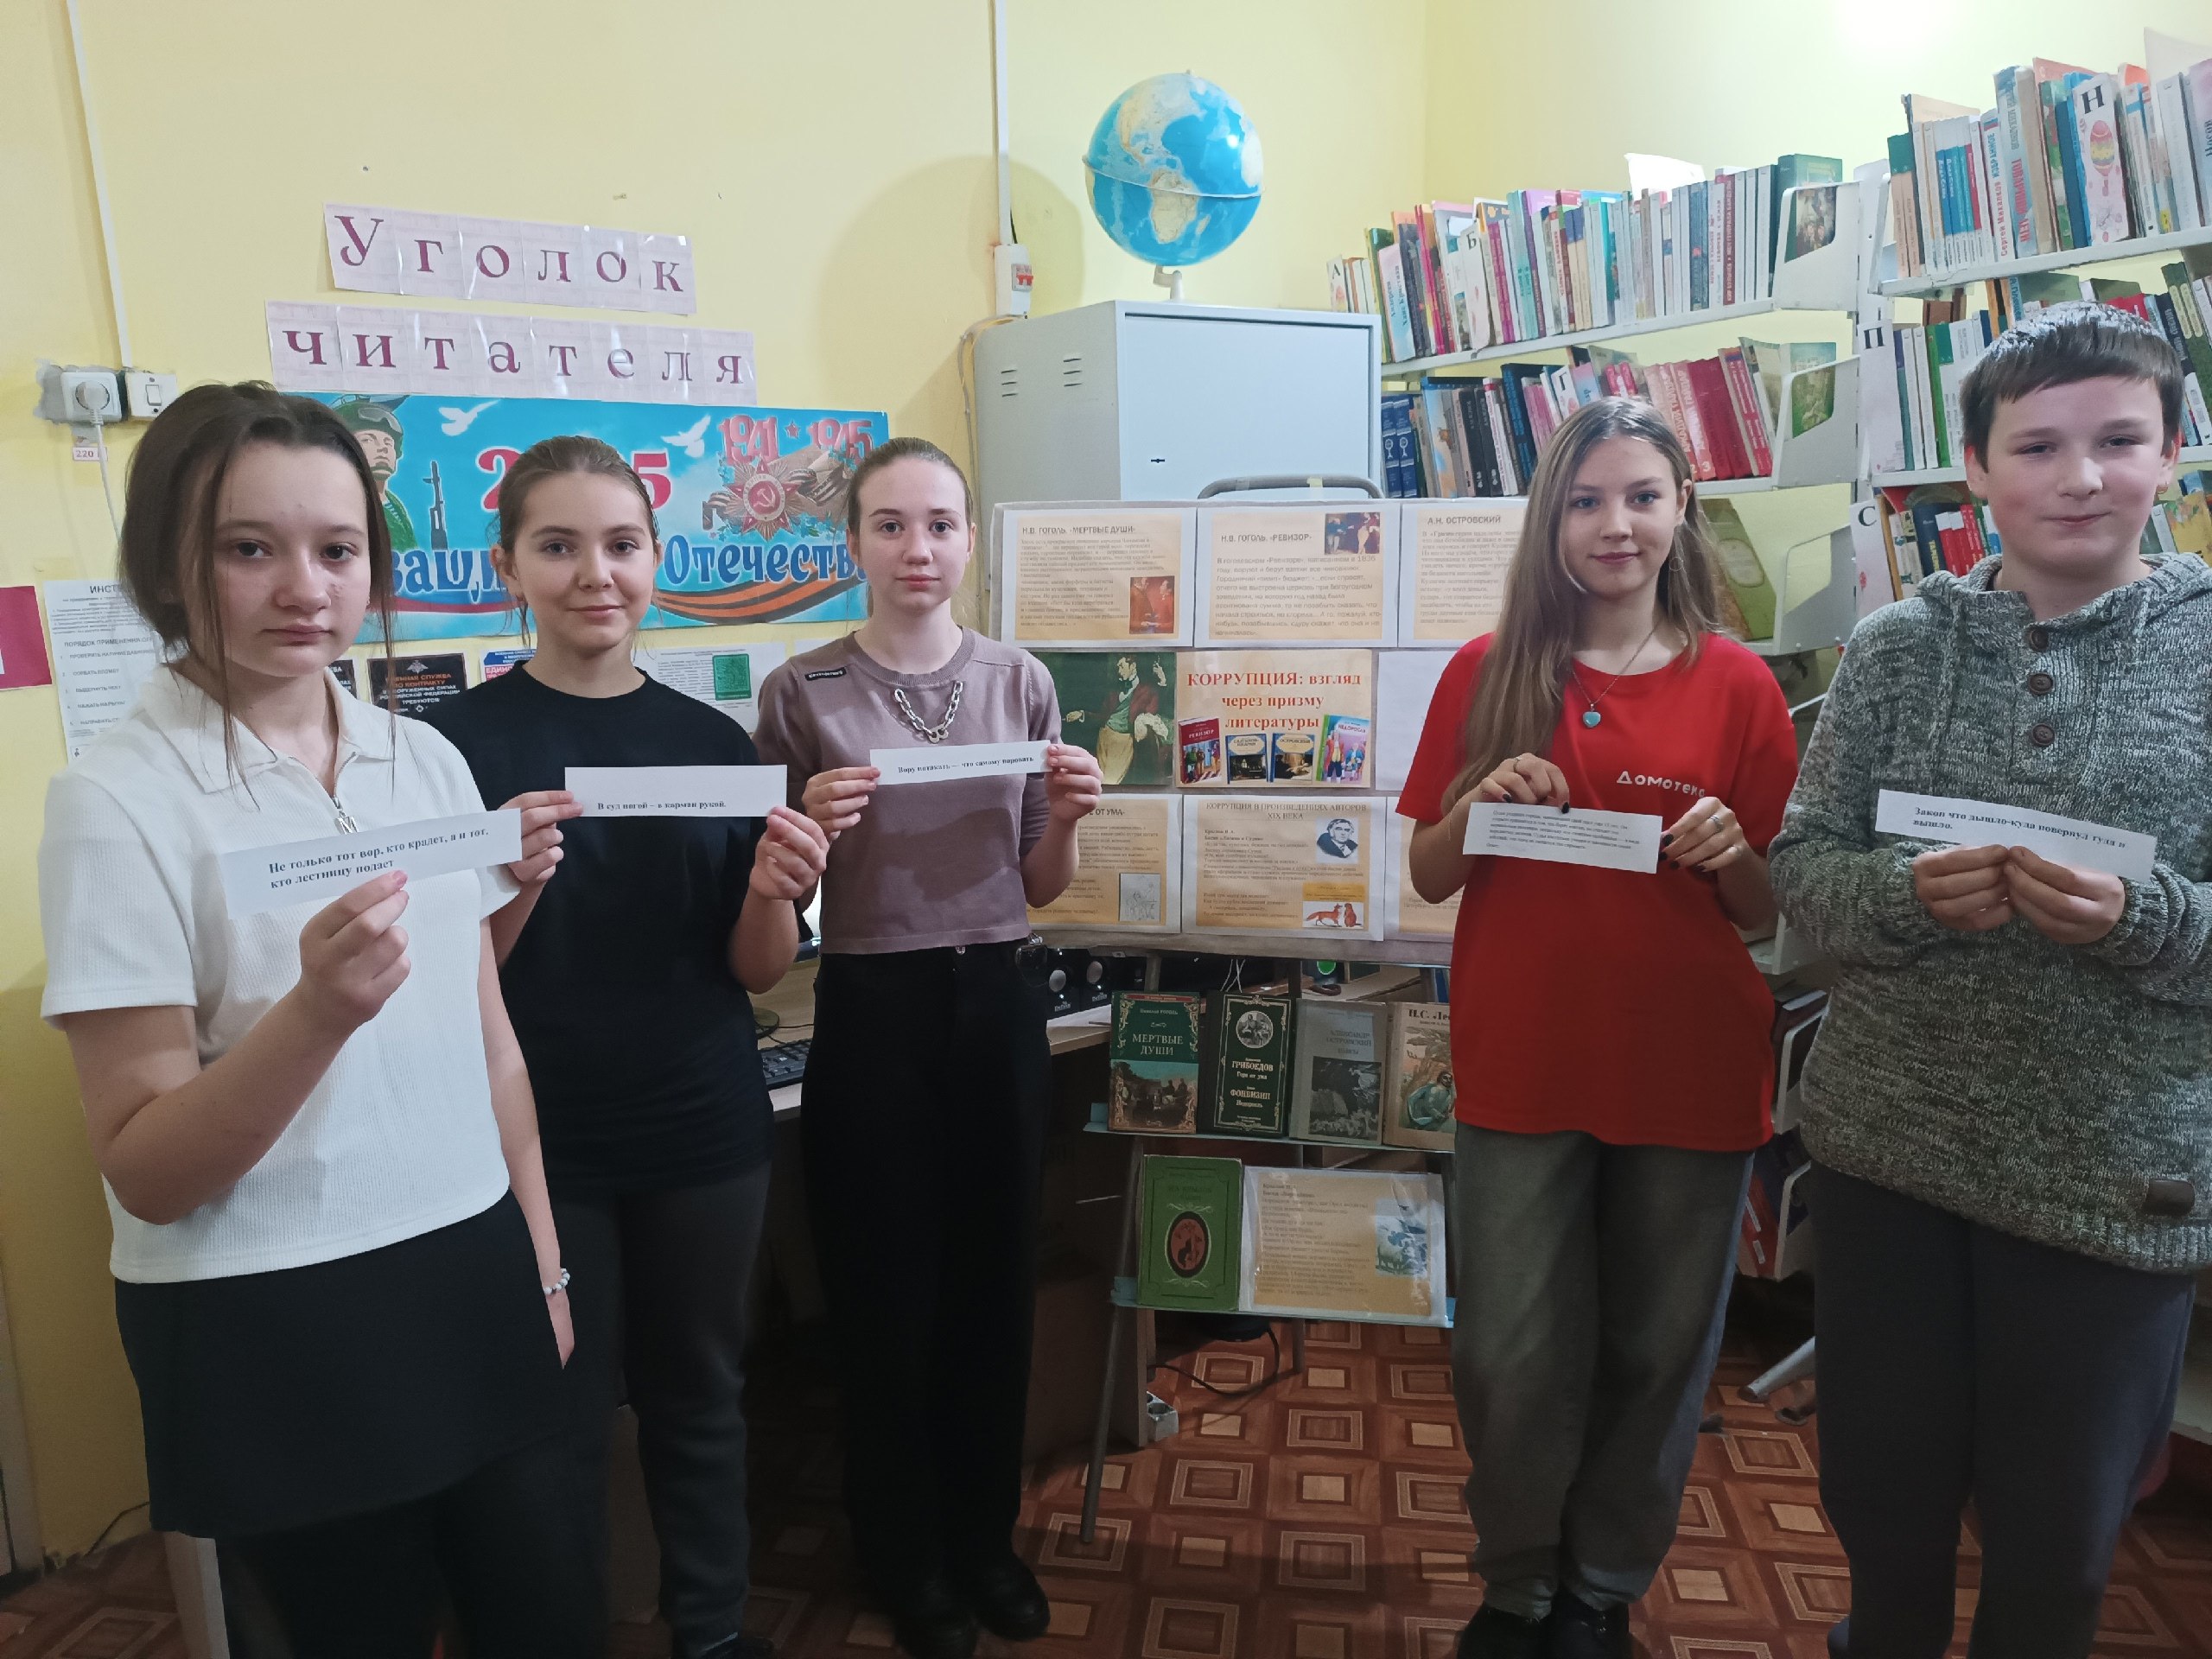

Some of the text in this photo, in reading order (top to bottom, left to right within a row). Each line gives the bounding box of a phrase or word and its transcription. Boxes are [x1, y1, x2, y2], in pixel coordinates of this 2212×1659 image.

[2082, 85, 2105, 114] Н
[1467, 231, 1477, 250] Б
[334, 214, 685, 292] Уголок
[1864, 327, 1884, 349] П
[283, 329, 744, 385] читателя
[719, 415, 779, 466] 1941
[75, 449, 94, 458] 220
[1446, 515, 1501, 524] ОСТРОВСКИЙ
[1859, 505, 1877, 527] С
[1187, 672, 1362, 688] КОРРУПЦИЯ: взгляд
[1222, 696, 1325, 709] через призму
[1225, 717, 1320, 730] литературы
[598, 802, 605, 810] В
[606, 803, 620, 811] суд
[622, 801, 648, 810] ногой
[664, 802, 697, 810] карман
[699, 800, 727, 810] рукой.
[1913, 819, 1954, 830] вышло.
[1915, 806, 1945, 818] Закон
[1968, 814, 2036, 830] дышло-куда
[2037, 824, 2088, 840] повернул
[2091, 834, 2117, 848] туда
[269, 862, 286, 874] Не
[289, 855, 333, 870] только
[335, 853, 357, 862] тот
[386, 843, 405, 854] кто
[270, 879, 292, 889] кто
[295, 866, 353, 885] лестницу
[1132, 1033, 1184, 1045] МЕРТВЫЕ
[1141, 1046, 1173, 1056] ДУШИ
[1231, 1060, 1274, 1071] ГРИБОЕДОВ
[1230, 1089, 1271, 1100] ФОНВИЗИН
